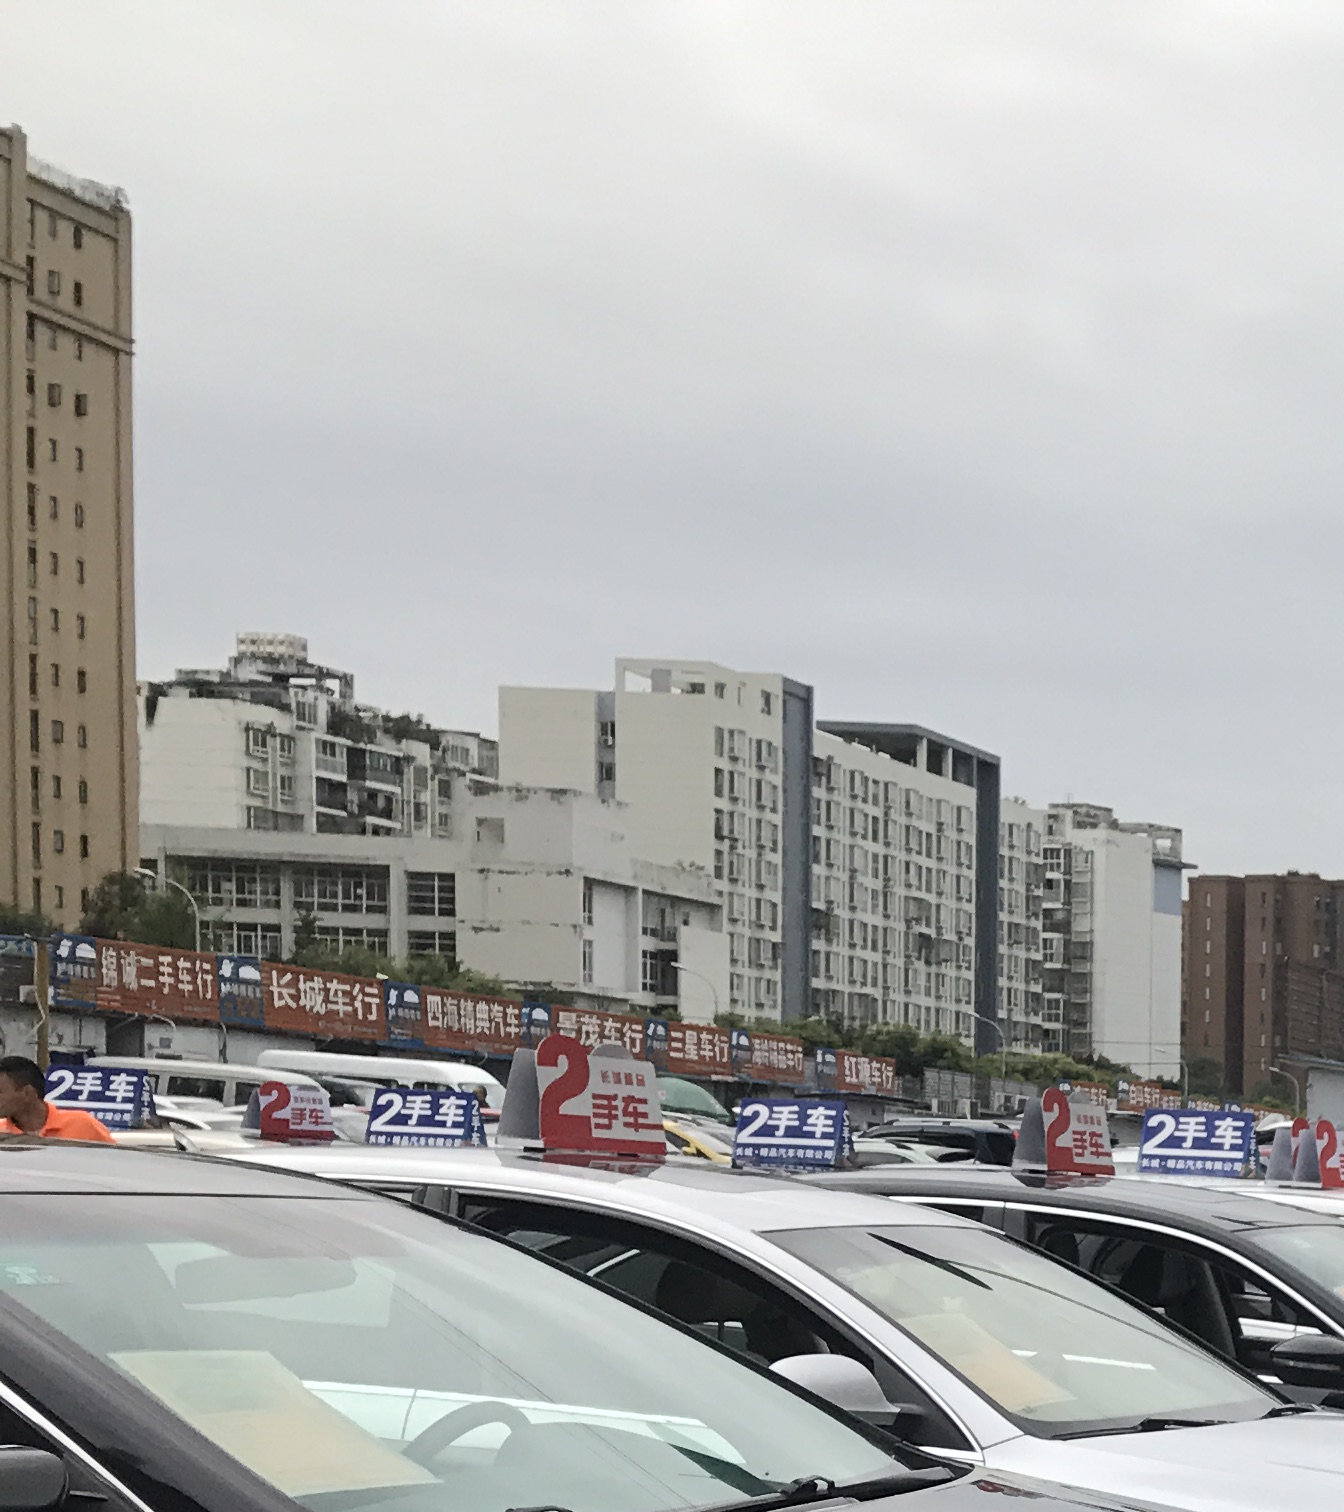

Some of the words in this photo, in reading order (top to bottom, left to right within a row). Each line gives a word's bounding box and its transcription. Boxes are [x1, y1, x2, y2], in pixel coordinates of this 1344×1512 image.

[269, 970, 381, 1021] 长城车行
[669, 1030, 730, 1063] 三星车行
[44, 1069, 138, 1103] 2手车
[537, 1033, 667, 1155] 2手车
[369, 1092, 468, 1132] 2手车
[736, 1103, 837, 1144] 2手车
[1043, 1087, 1115, 1175] 2手车
[1141, 1113, 1245, 1155] 2手车
